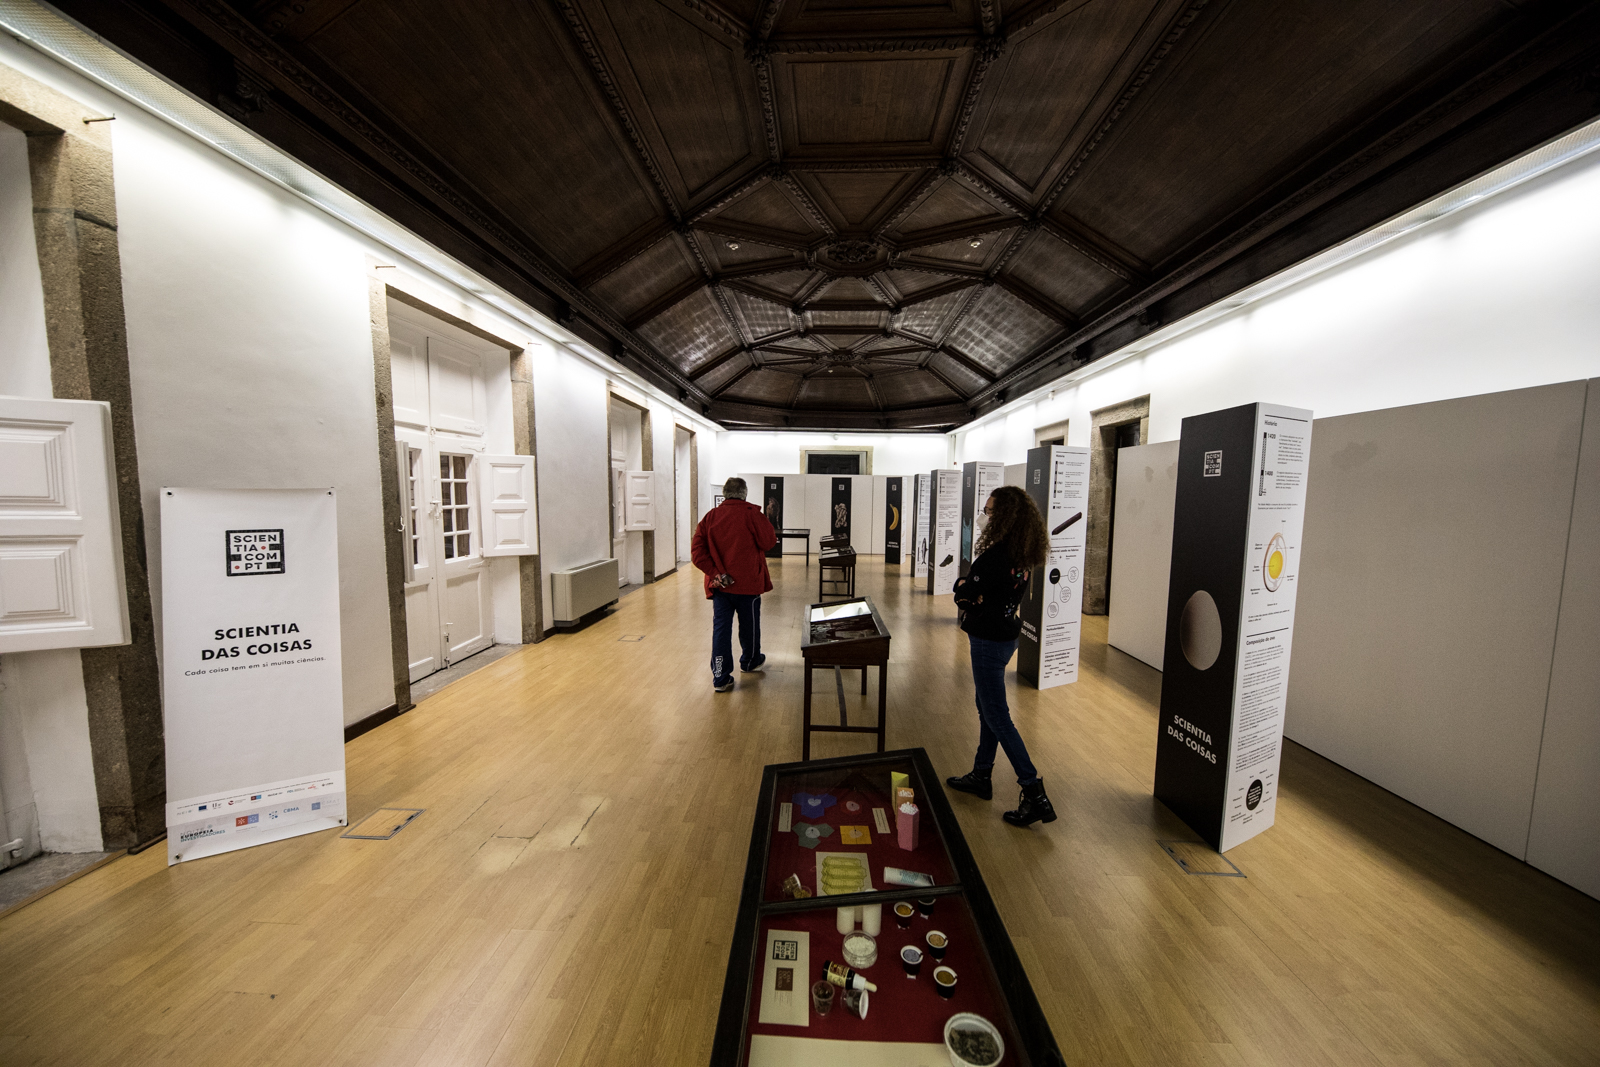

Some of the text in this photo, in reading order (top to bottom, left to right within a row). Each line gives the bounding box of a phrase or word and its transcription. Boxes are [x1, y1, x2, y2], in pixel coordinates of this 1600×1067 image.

[233, 534, 277, 543] SCIEN
[244, 552, 277, 561] COM
[214, 623, 300, 640] SCIENTIA
[201, 639, 312, 661] DAS COISAS
[1174, 714, 1212, 745] SCIENTIA
[1167, 725, 1184, 742] DAS
[1185, 737, 1216, 764] COISAS
[181, 829, 213, 839] EUROPEIA
